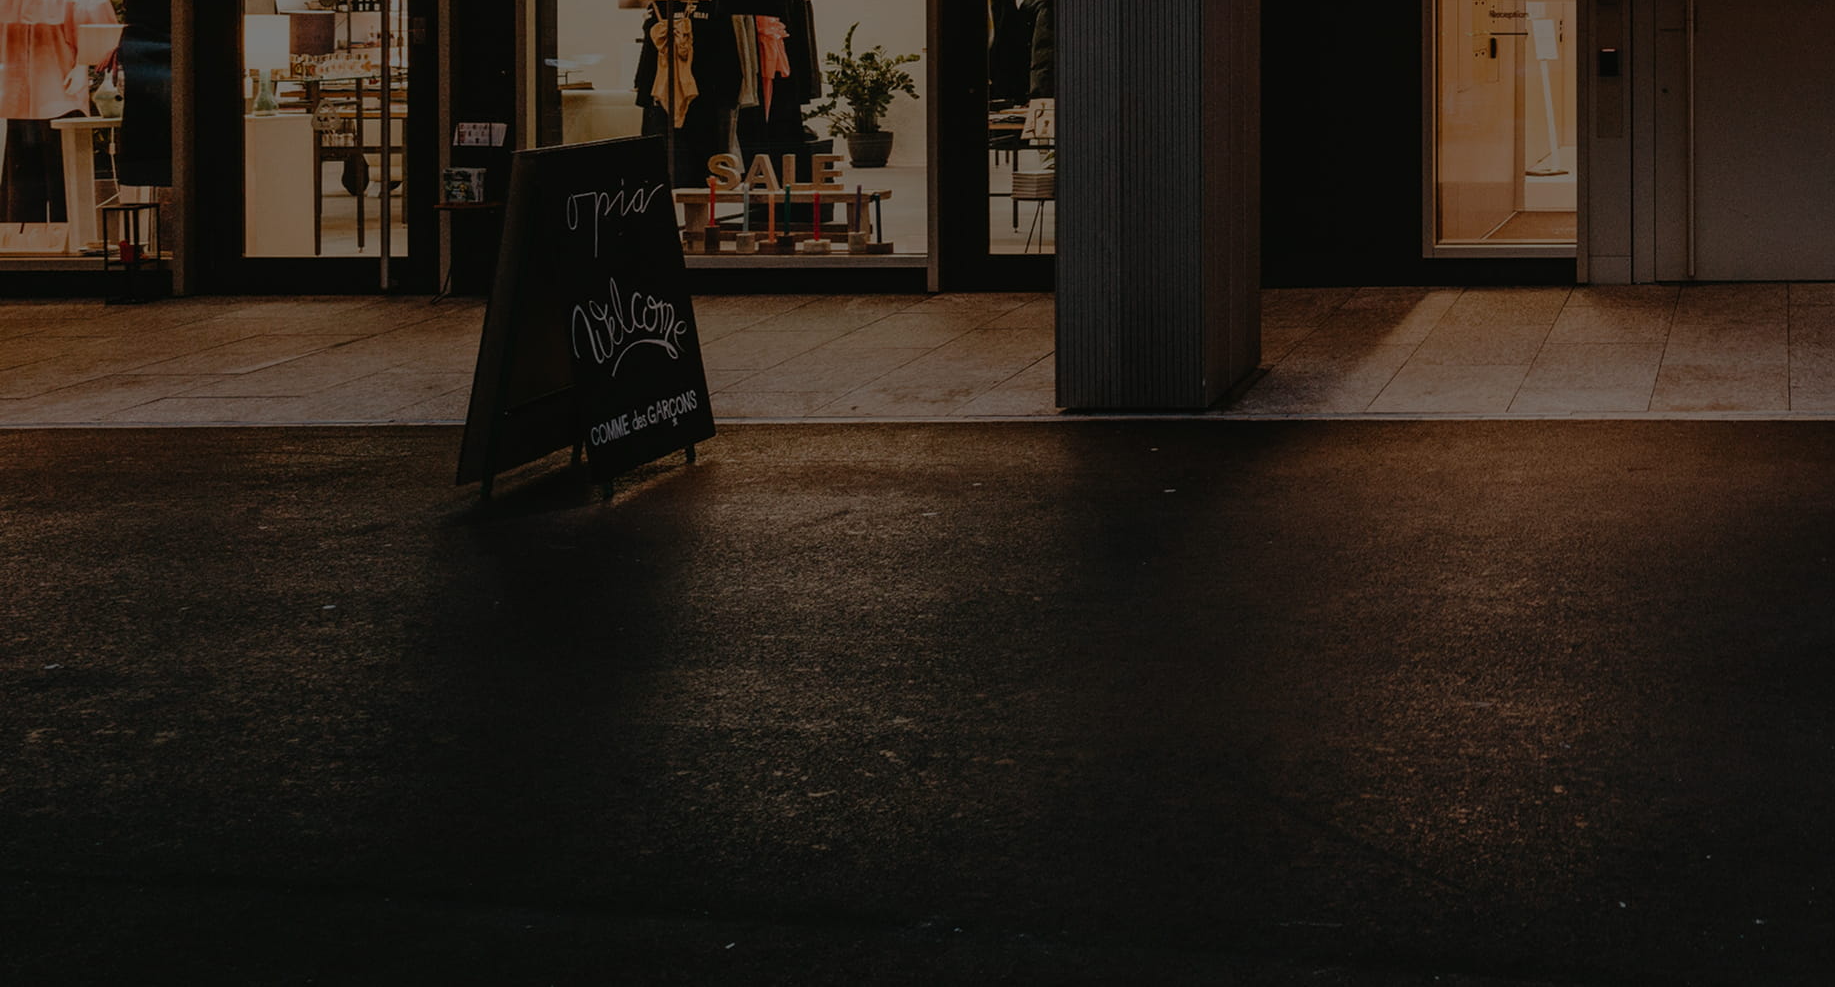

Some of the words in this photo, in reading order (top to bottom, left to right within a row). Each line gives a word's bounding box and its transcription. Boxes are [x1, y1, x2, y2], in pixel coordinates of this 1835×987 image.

[706, 153, 845, 191] SALE
[566, 177, 664, 258] opia
[571, 277, 688, 377] Welcome
[590, 413, 631, 446] COMME
[632, 409, 648, 430] des
[647, 389, 698, 427] GARÇONS
